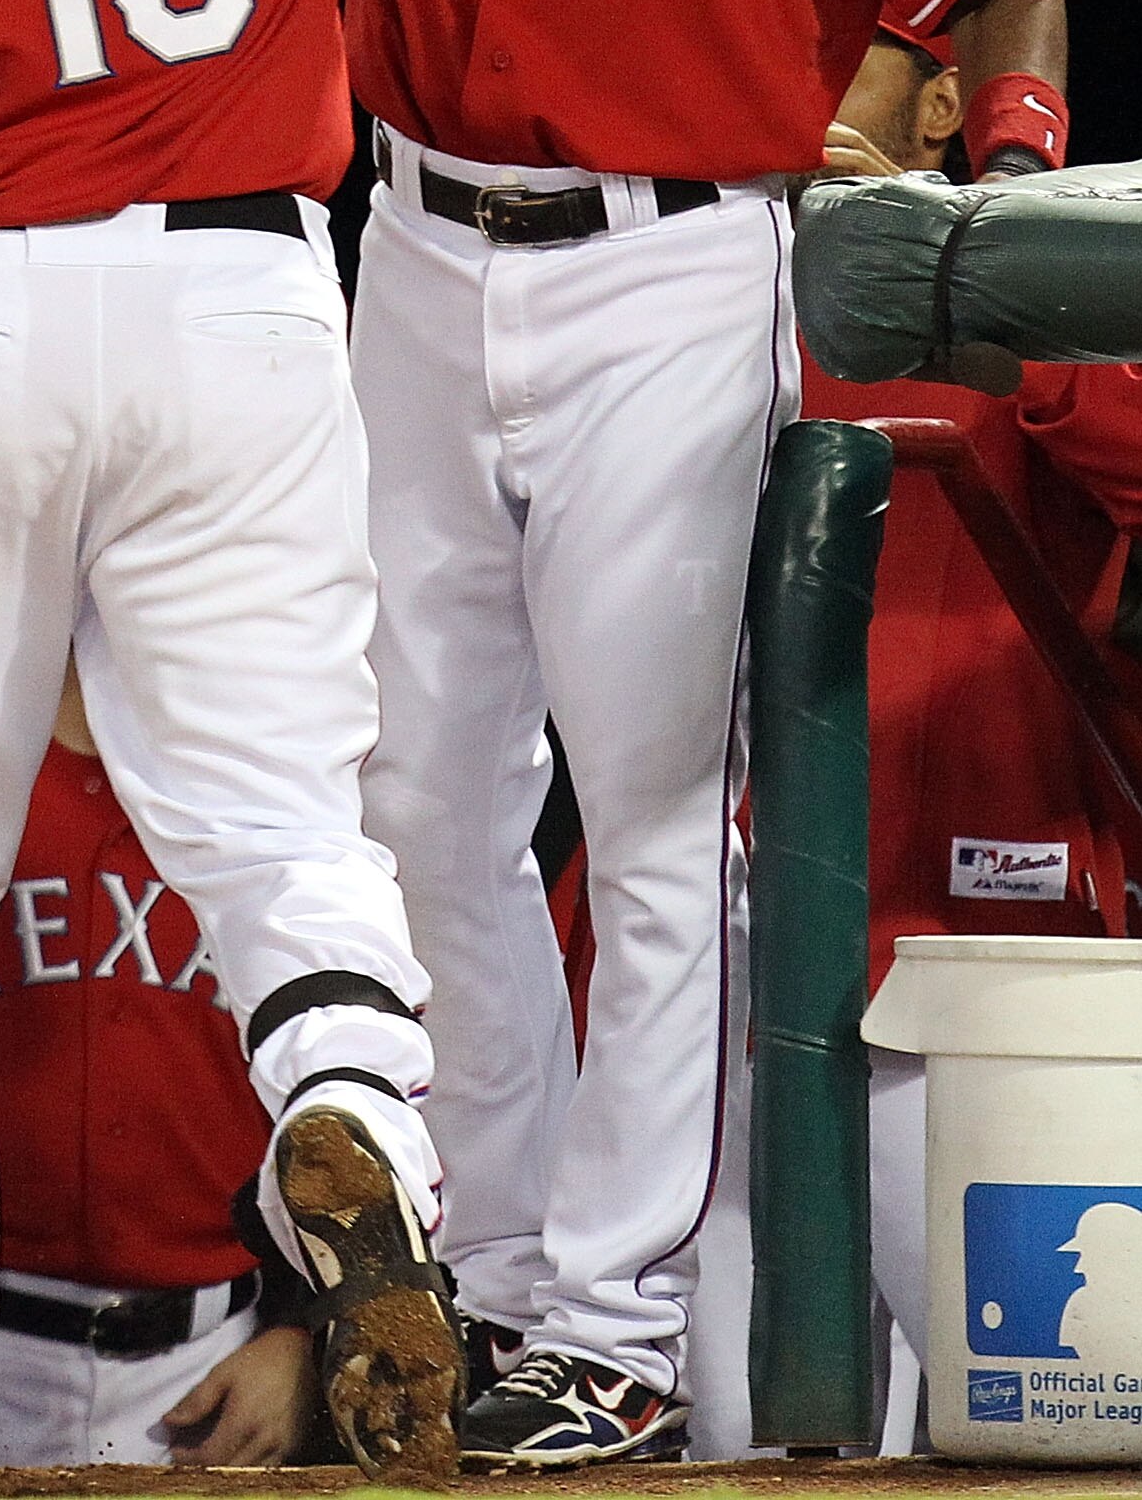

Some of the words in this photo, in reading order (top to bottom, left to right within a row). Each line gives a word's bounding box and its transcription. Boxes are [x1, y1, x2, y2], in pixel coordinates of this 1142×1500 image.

[1029, 1371, 1106, 1393] Official
[1113, 1373, 1142, 1393] Ga
[1030, 1399, 1087, 1425] Major
[1094, 1400, 1142, 1425] Leag
